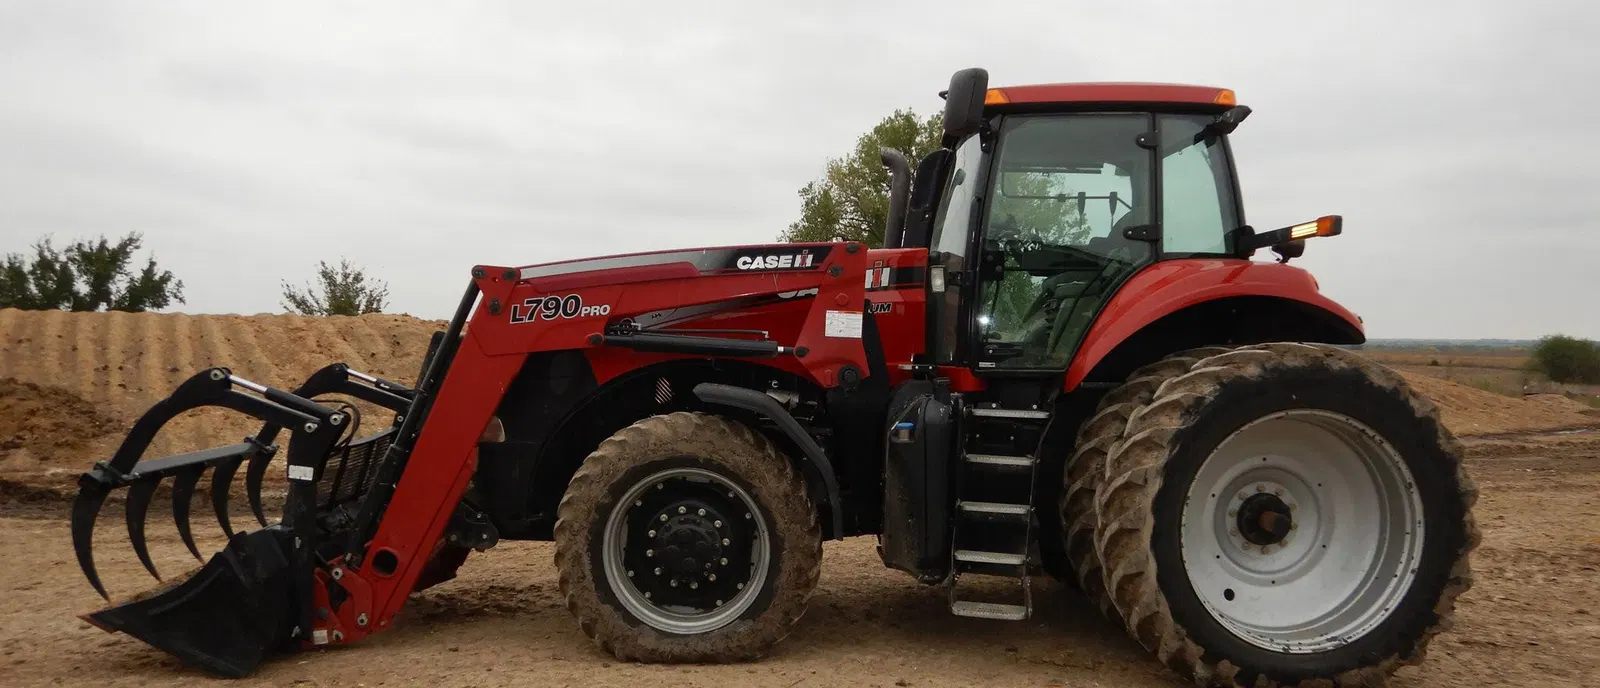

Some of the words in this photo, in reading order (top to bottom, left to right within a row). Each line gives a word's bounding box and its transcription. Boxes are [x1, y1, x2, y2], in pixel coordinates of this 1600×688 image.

[737, 255, 792, 270] CASE
[510, 293, 582, 324] L790
[581, 304, 611, 317] PRO
